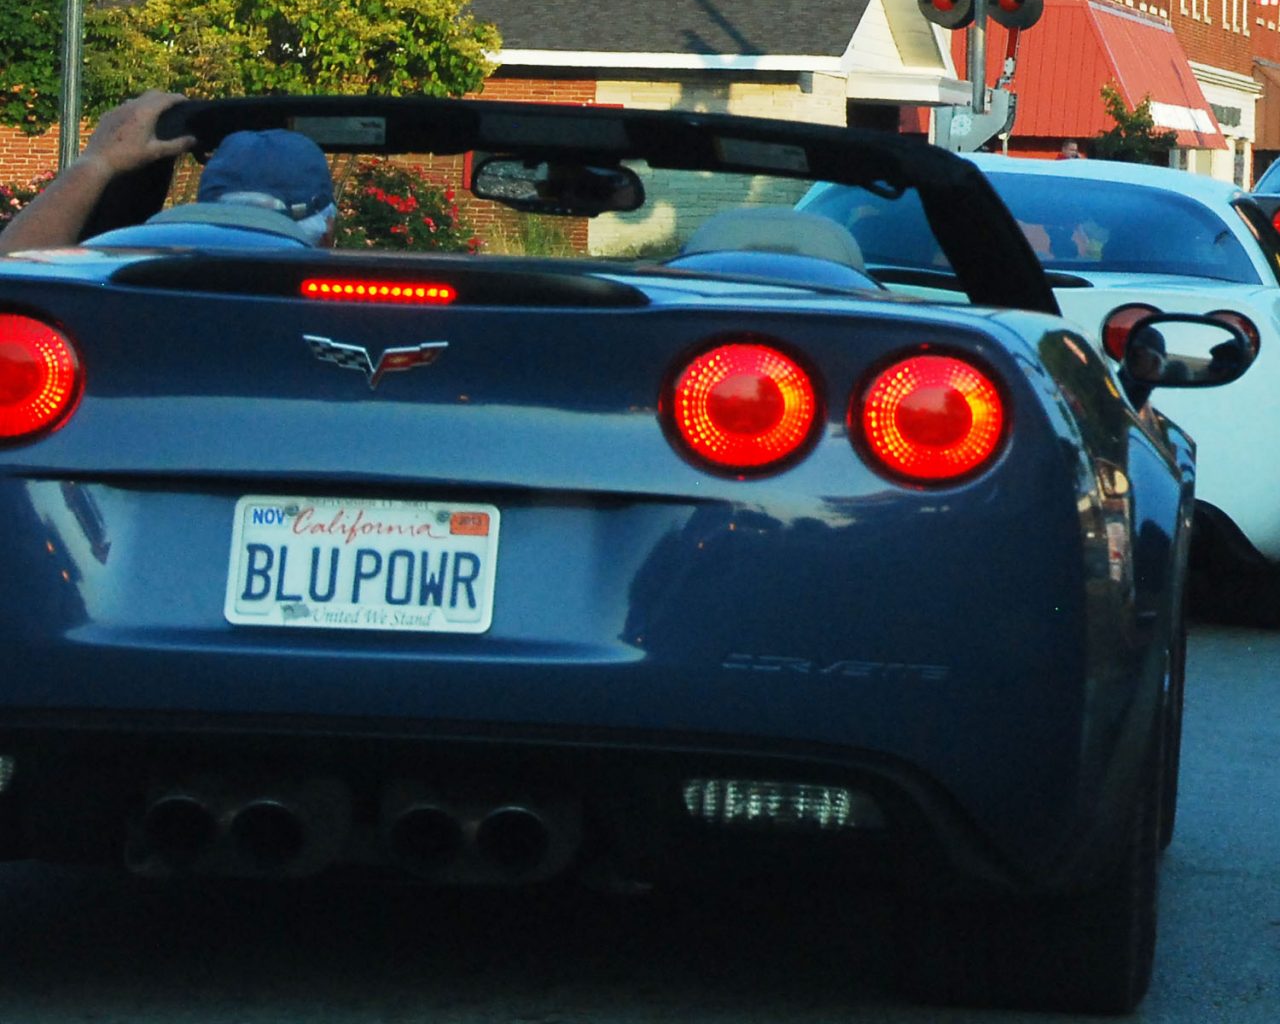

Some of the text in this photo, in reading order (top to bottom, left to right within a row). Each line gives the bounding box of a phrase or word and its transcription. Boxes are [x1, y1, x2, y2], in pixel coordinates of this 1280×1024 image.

[252, 507, 285, 526] NOV
[291, 505, 448, 545] California
[312, 607, 435, 628] United We Stand
